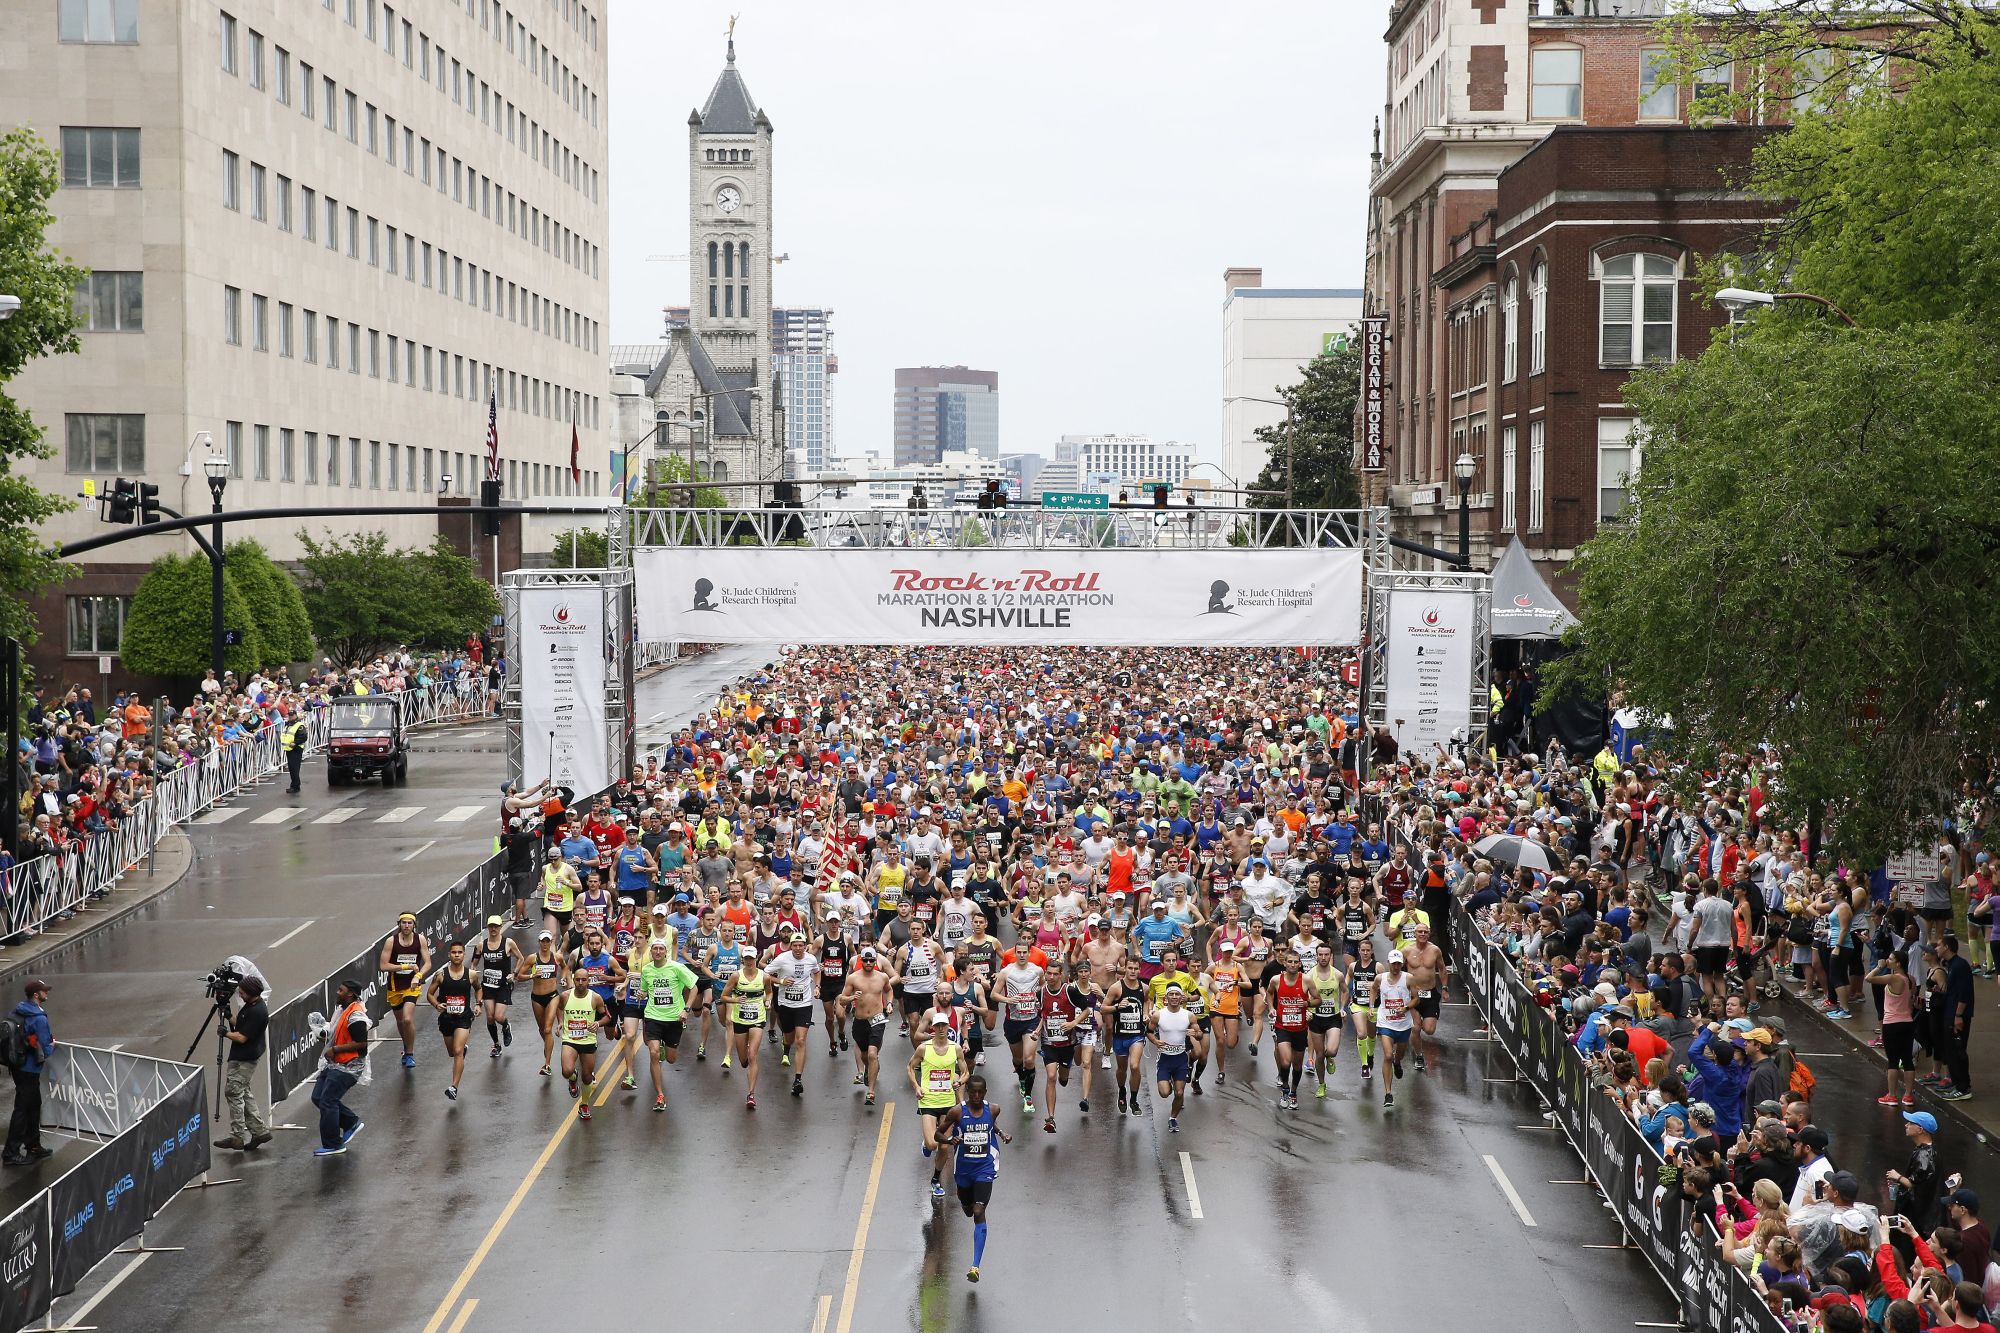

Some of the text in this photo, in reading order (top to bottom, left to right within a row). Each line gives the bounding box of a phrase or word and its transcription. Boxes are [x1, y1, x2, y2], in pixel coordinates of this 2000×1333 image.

[1367, 321, 1382, 467] MORGAN & MORGAN
[1094, 497, 1101, 505] S
[890, 569, 989, 591] Rock
[1020, 569, 1101, 592] Roll
[721, 587, 797, 597] St. Jude Children's
[1237, 588, 1313, 598] St. Jude Children's
[721, 596, 797, 607] Research Hospital
[877, 592, 1114, 607] MARATHON & 1/2 MARATHON
[1237, 597, 1313, 608] Research Hospital
[921, 607, 1071, 628] NASHVILLE
[1348, 666, 1358, 682] E
[1121, 677, 1128, 687] 2
[969, 1145, 983, 1153] 201
